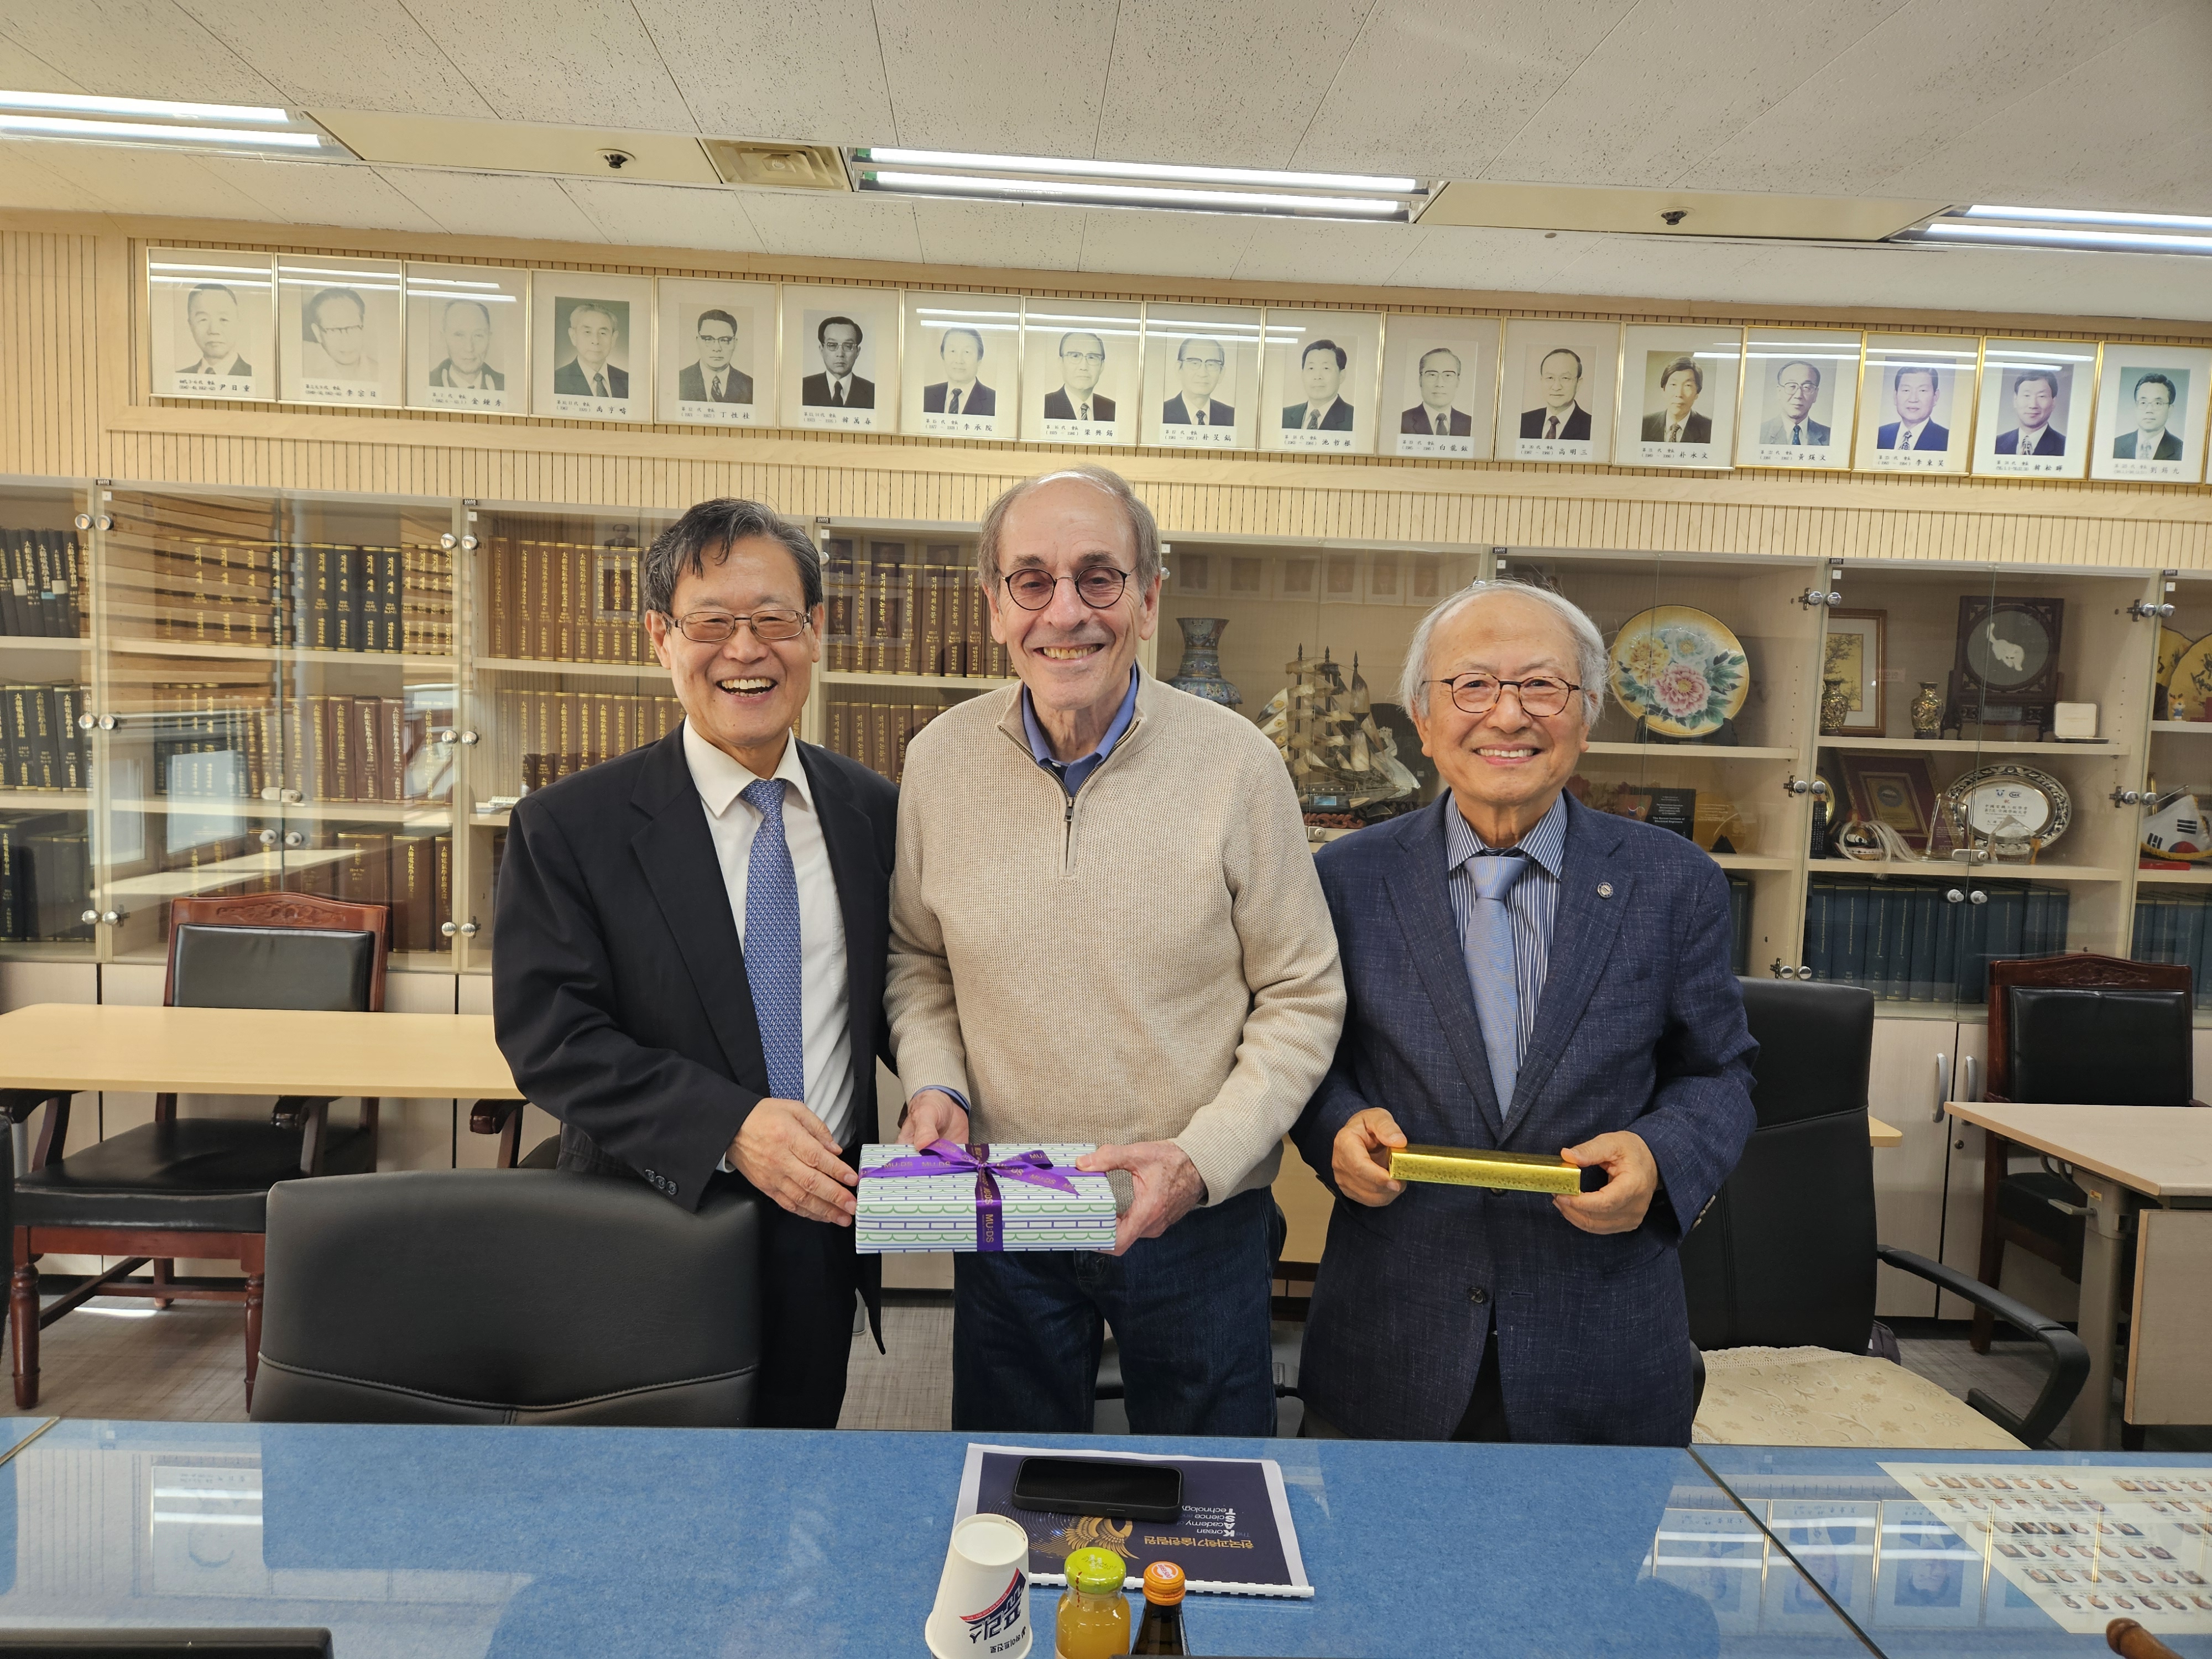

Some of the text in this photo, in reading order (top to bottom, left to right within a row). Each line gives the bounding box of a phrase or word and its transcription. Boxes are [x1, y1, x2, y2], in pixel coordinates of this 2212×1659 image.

[985, 1214, 994, 1243] MU:DS
[1182, 1505, 1236, 1515] Technology
[1194, 1514, 1235, 1522] Science
[1185, 1520, 1235, 1529] Academy
[1197, 1528, 1235, 1537] Korean
[1144, 1536, 1254, 1548] 한국과학기술한림원
[989, 1634, 1020, 1653] 하이트진로
